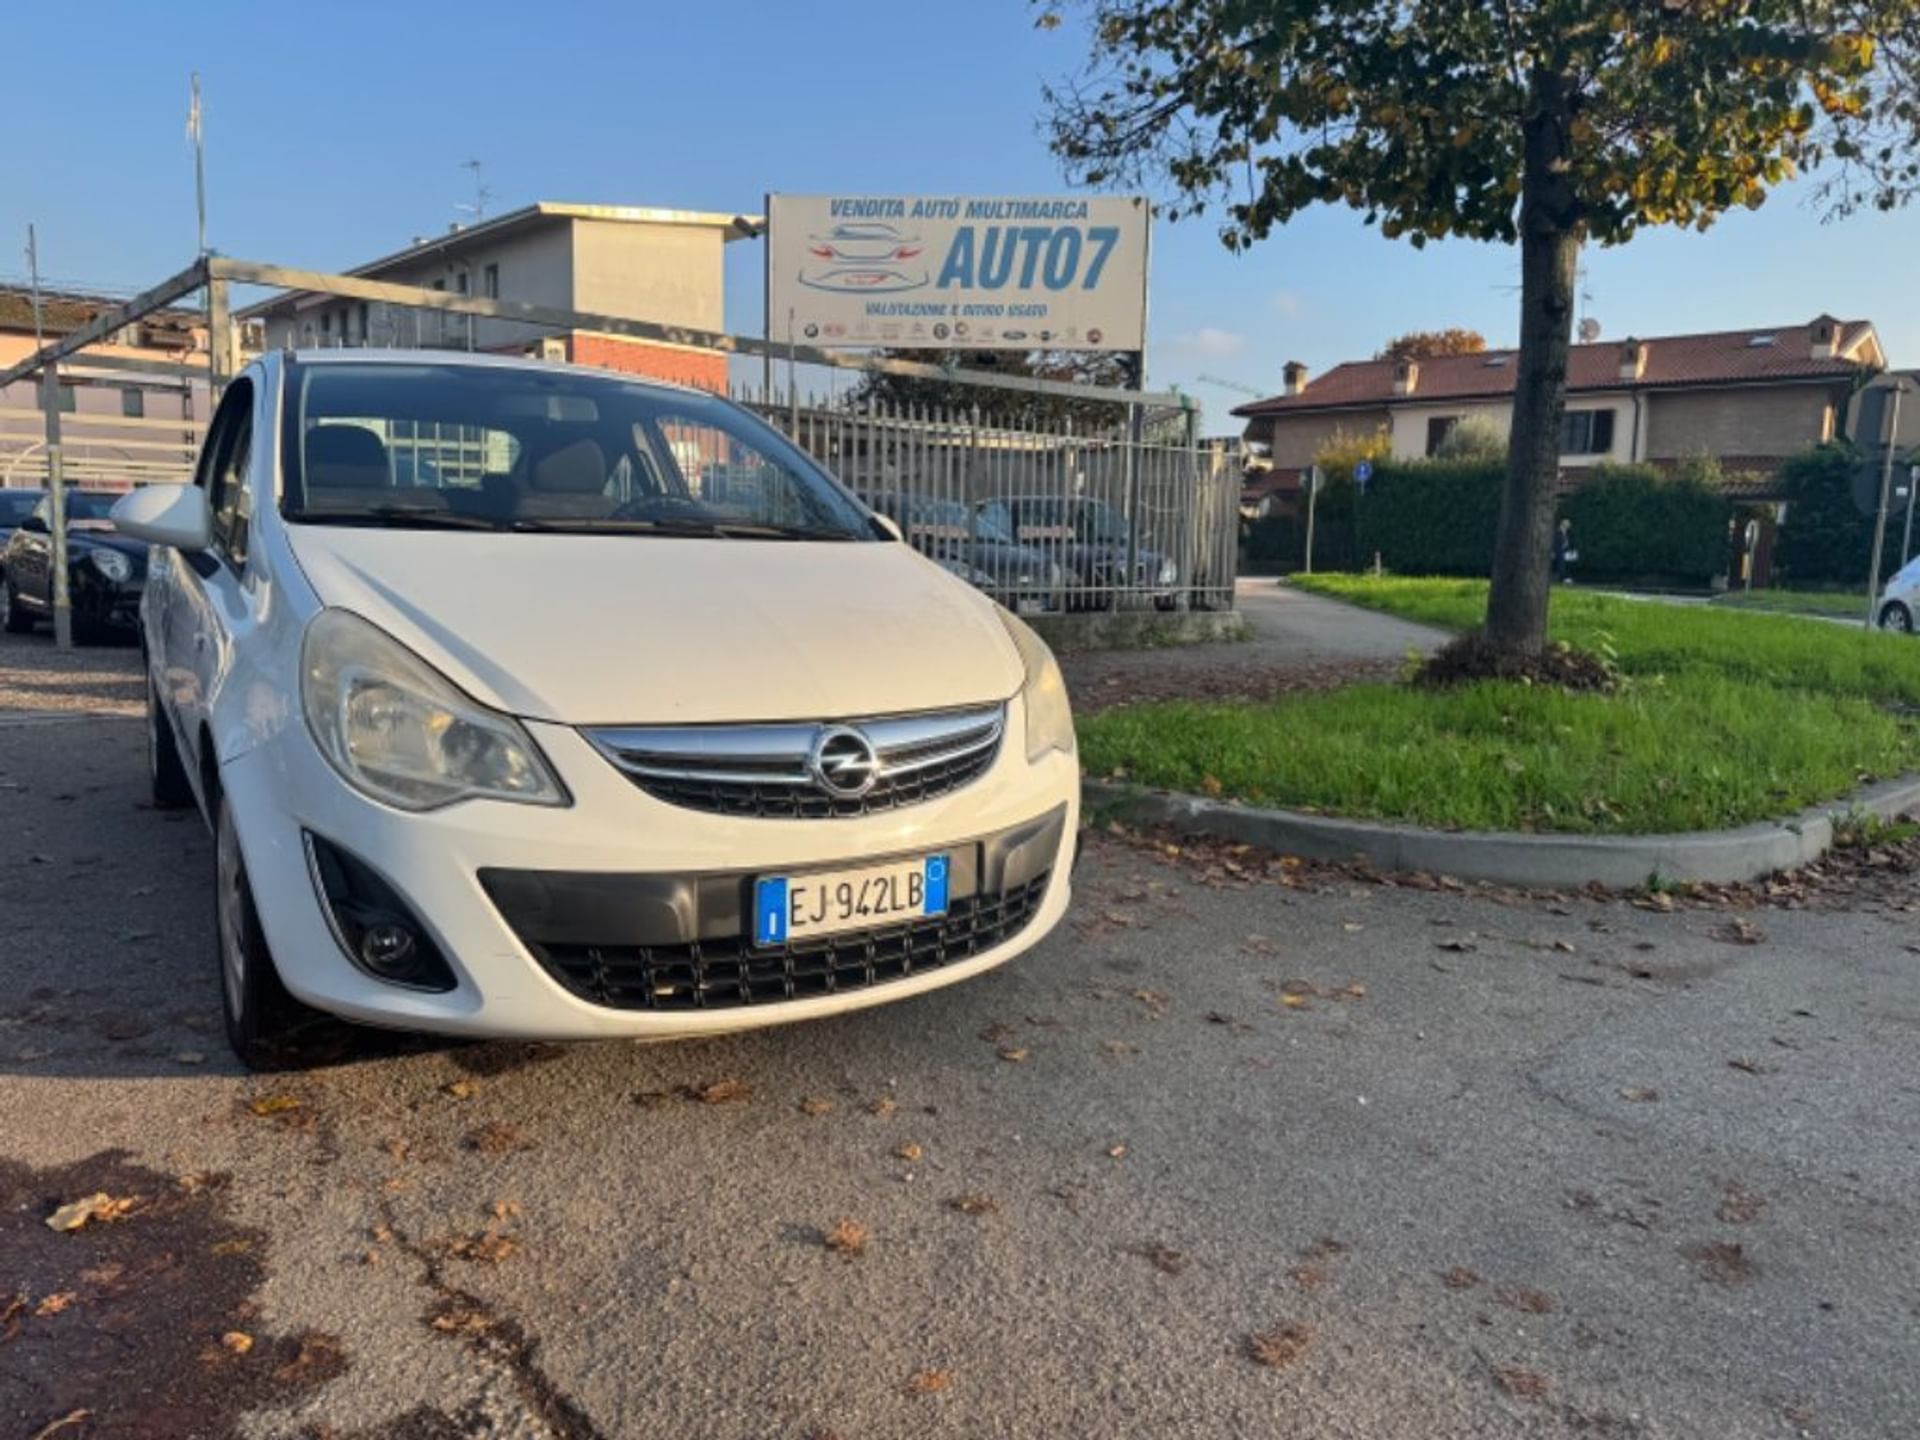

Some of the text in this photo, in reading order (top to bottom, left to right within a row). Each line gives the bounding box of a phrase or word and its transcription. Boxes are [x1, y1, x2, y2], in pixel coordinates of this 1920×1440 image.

[830, 199, 905, 217] VENDITA
[965, 201, 1088, 219] MULTIMARCA
[936, 226, 1121, 290] AUTO7
[865, 301, 946, 316] VALUTAZIONE
[1008, 303, 1048, 317] USATO
